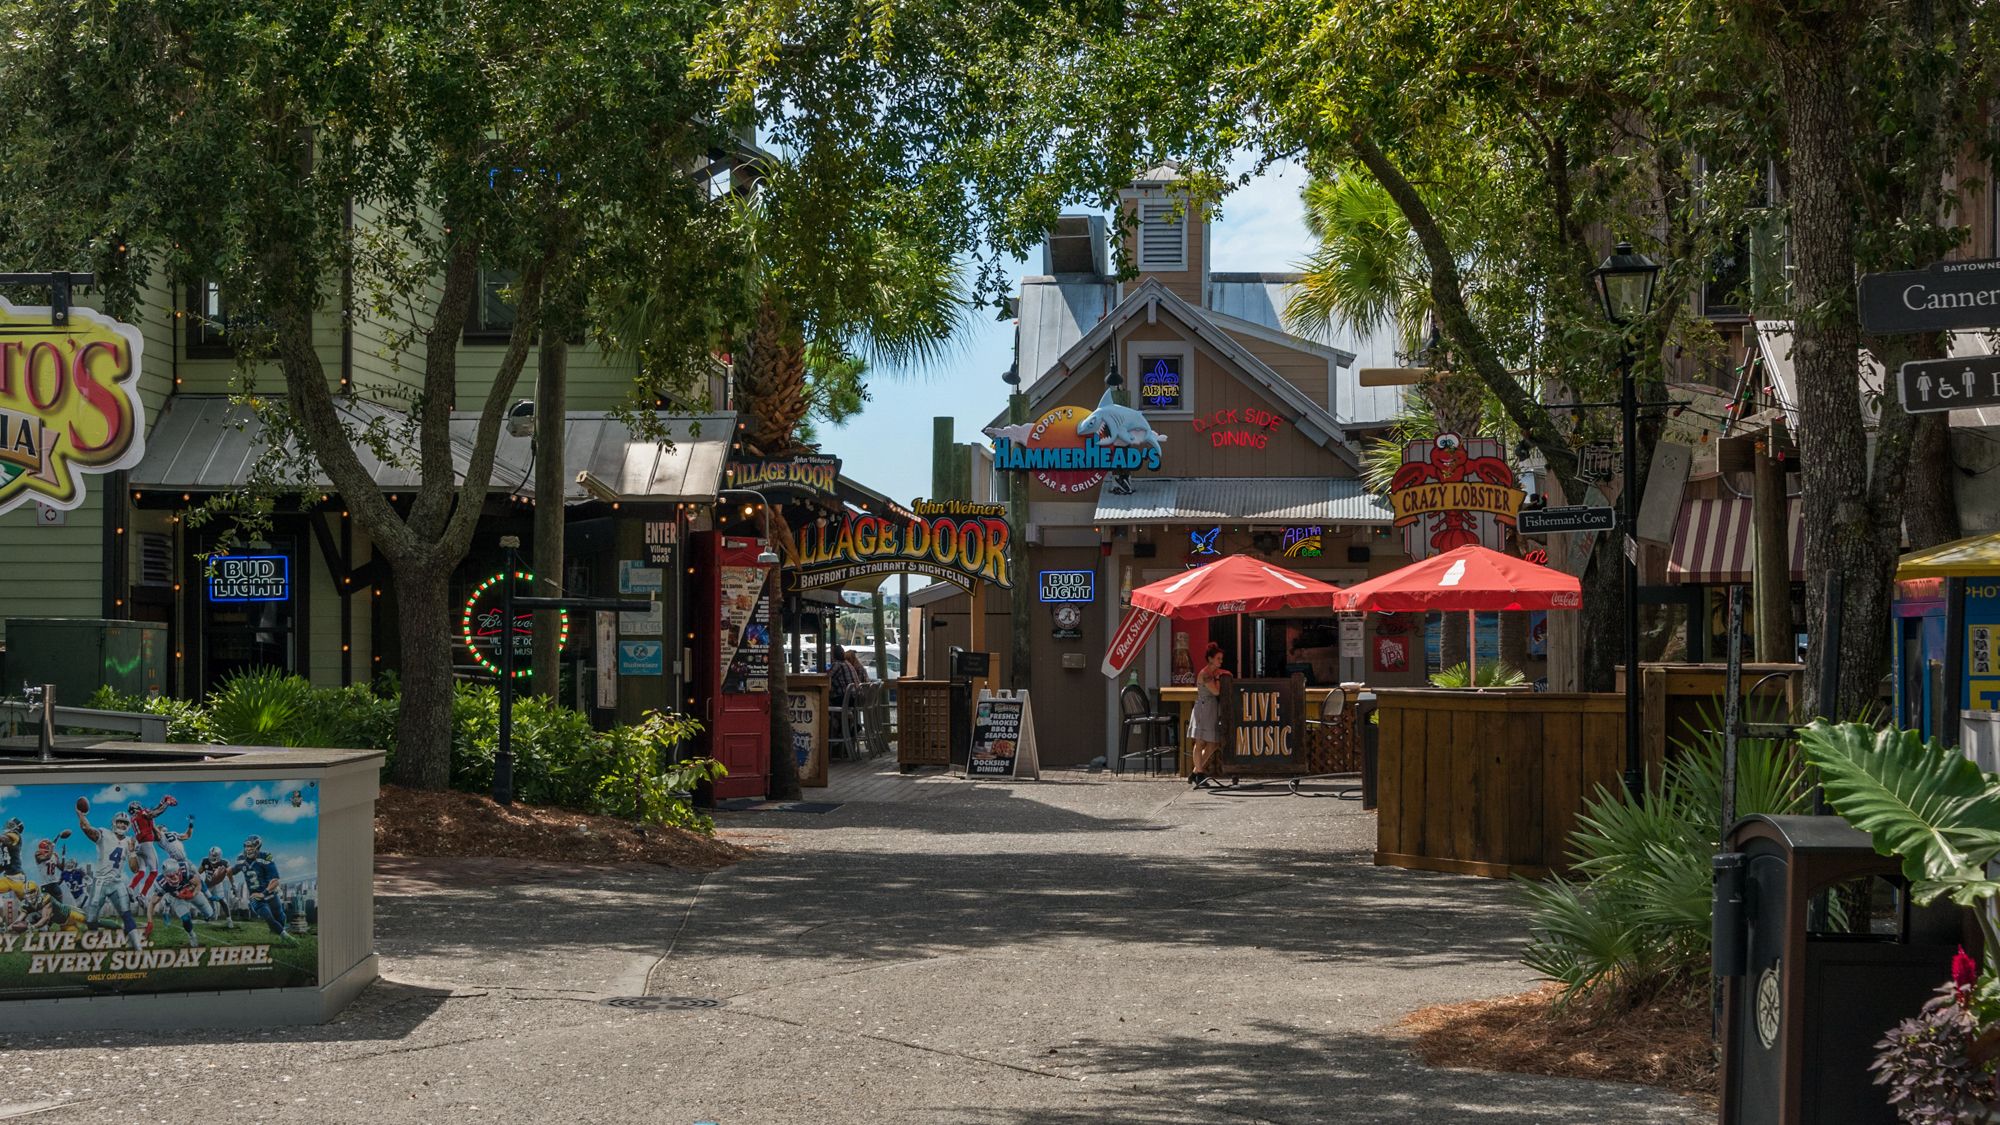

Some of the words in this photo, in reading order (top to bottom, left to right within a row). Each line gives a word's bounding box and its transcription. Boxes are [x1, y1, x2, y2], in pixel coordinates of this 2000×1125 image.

[1142, 385, 1179, 397] ABITA
[1031, 408, 1074, 441] POPPY'S
[1192, 409, 1239, 433] DOCK
[1244, 407, 1283, 432] SIDE
[1211, 430, 1268, 449] DINING
[789, 463, 838, 496] DOOR
[1037, 472, 1057, 489] BAR
[1060, 484, 1067, 493] &
[1071, 472, 1103, 493] GRILLE
[911, 497, 946, 516] John
[946, 499, 1006, 517] Wehner's
[1402, 486, 1448, 513] CRAZY
[1453, 485, 1511, 513] LOBSTER
[1525, 514, 1581, 528] Fisherman's
[1582, 512, 1608, 525] Cove
[645, 521, 677, 544] ENTER
[1283, 526, 1322, 550] ABITA
[651, 554, 670, 564] DOOR
[900, 515, 1013, 589] DOOR
[224, 560, 275, 578] BUD
[800, 567, 847, 589] BAYFRONT
[850, 561, 906, 578] RESTAURANT
[908, 562, 917, 571] &
[919, 563, 970, 589] NIGHTCLUB
[1049, 573, 1085, 586] BUD
[214, 577, 285, 597] LIGHT
[1042, 586, 1092, 599] LIGHT
[1115, 633, 1134, 659] Red
[1242, 691, 1281, 722] LIVE
[1236, 725, 1293, 757] MUSIC
[973, 759, 1010, 767] DOCKSIDE
[21, 930, 77, 952] LIVE
[28, 951, 109, 974] EVERY
[109, 947, 207, 971] SUNDAY
[207, 944, 273, 967] HERE.
